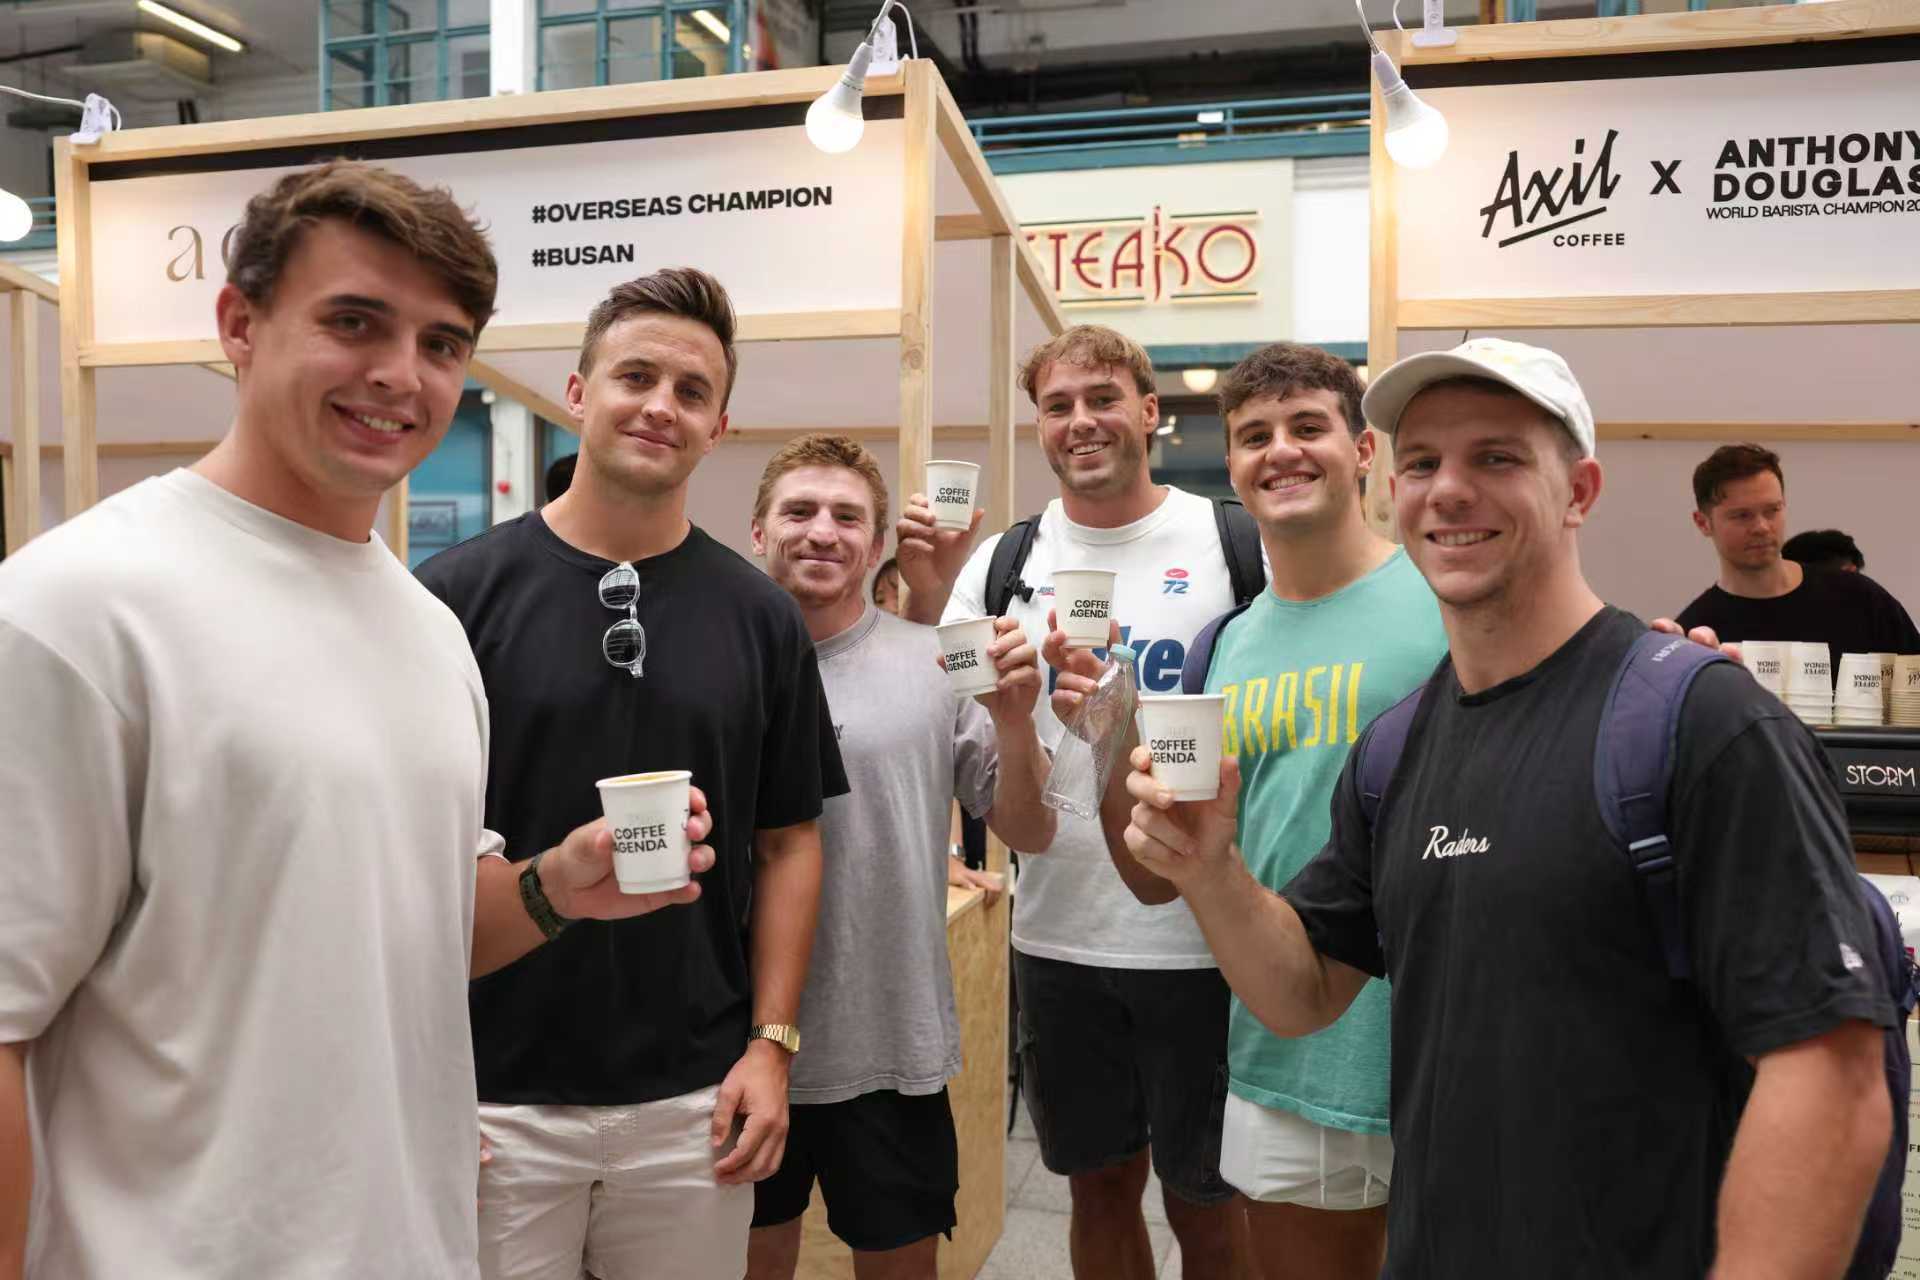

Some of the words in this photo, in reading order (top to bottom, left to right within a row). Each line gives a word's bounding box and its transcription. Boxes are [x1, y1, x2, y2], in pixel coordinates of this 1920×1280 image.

[1715, 130, 1920, 169] ANTHONY
[1480, 129, 1621, 238] Axil
[1713, 164, 1920, 202] DOUGLAS
[532, 195, 682, 223] #OVERSEAS
[688, 186, 832, 214] CHAMPION
[1706, 206, 1758, 219] WORLD
[1762, 203, 1819, 217] BARISTA
[1823, 200, 1905, 215] CHAMPION
[1553, 233, 1625, 247] COFFEE
[532, 244, 635, 267] #BUSAN
[1026, 205, 1256, 301] TEAKO
[935, 495, 969, 504] AGENDA
[939, 487, 971, 497] COFFEE
[1163, 580, 1189, 594] 72
[1074, 599, 1110, 609] COFFEE
[1069, 608, 1108, 618] AGENDA
[945, 649, 977, 663] COFFEE
[946, 659, 978, 671] GENDA
[1854, 674, 1881, 682] GENDA
[1221, 662, 1364, 757] BRASIL
[1151, 739, 1197, 751] COFFEE
[1846, 765, 1916, 787] STORM
[614, 824, 666, 840] COFFEE
